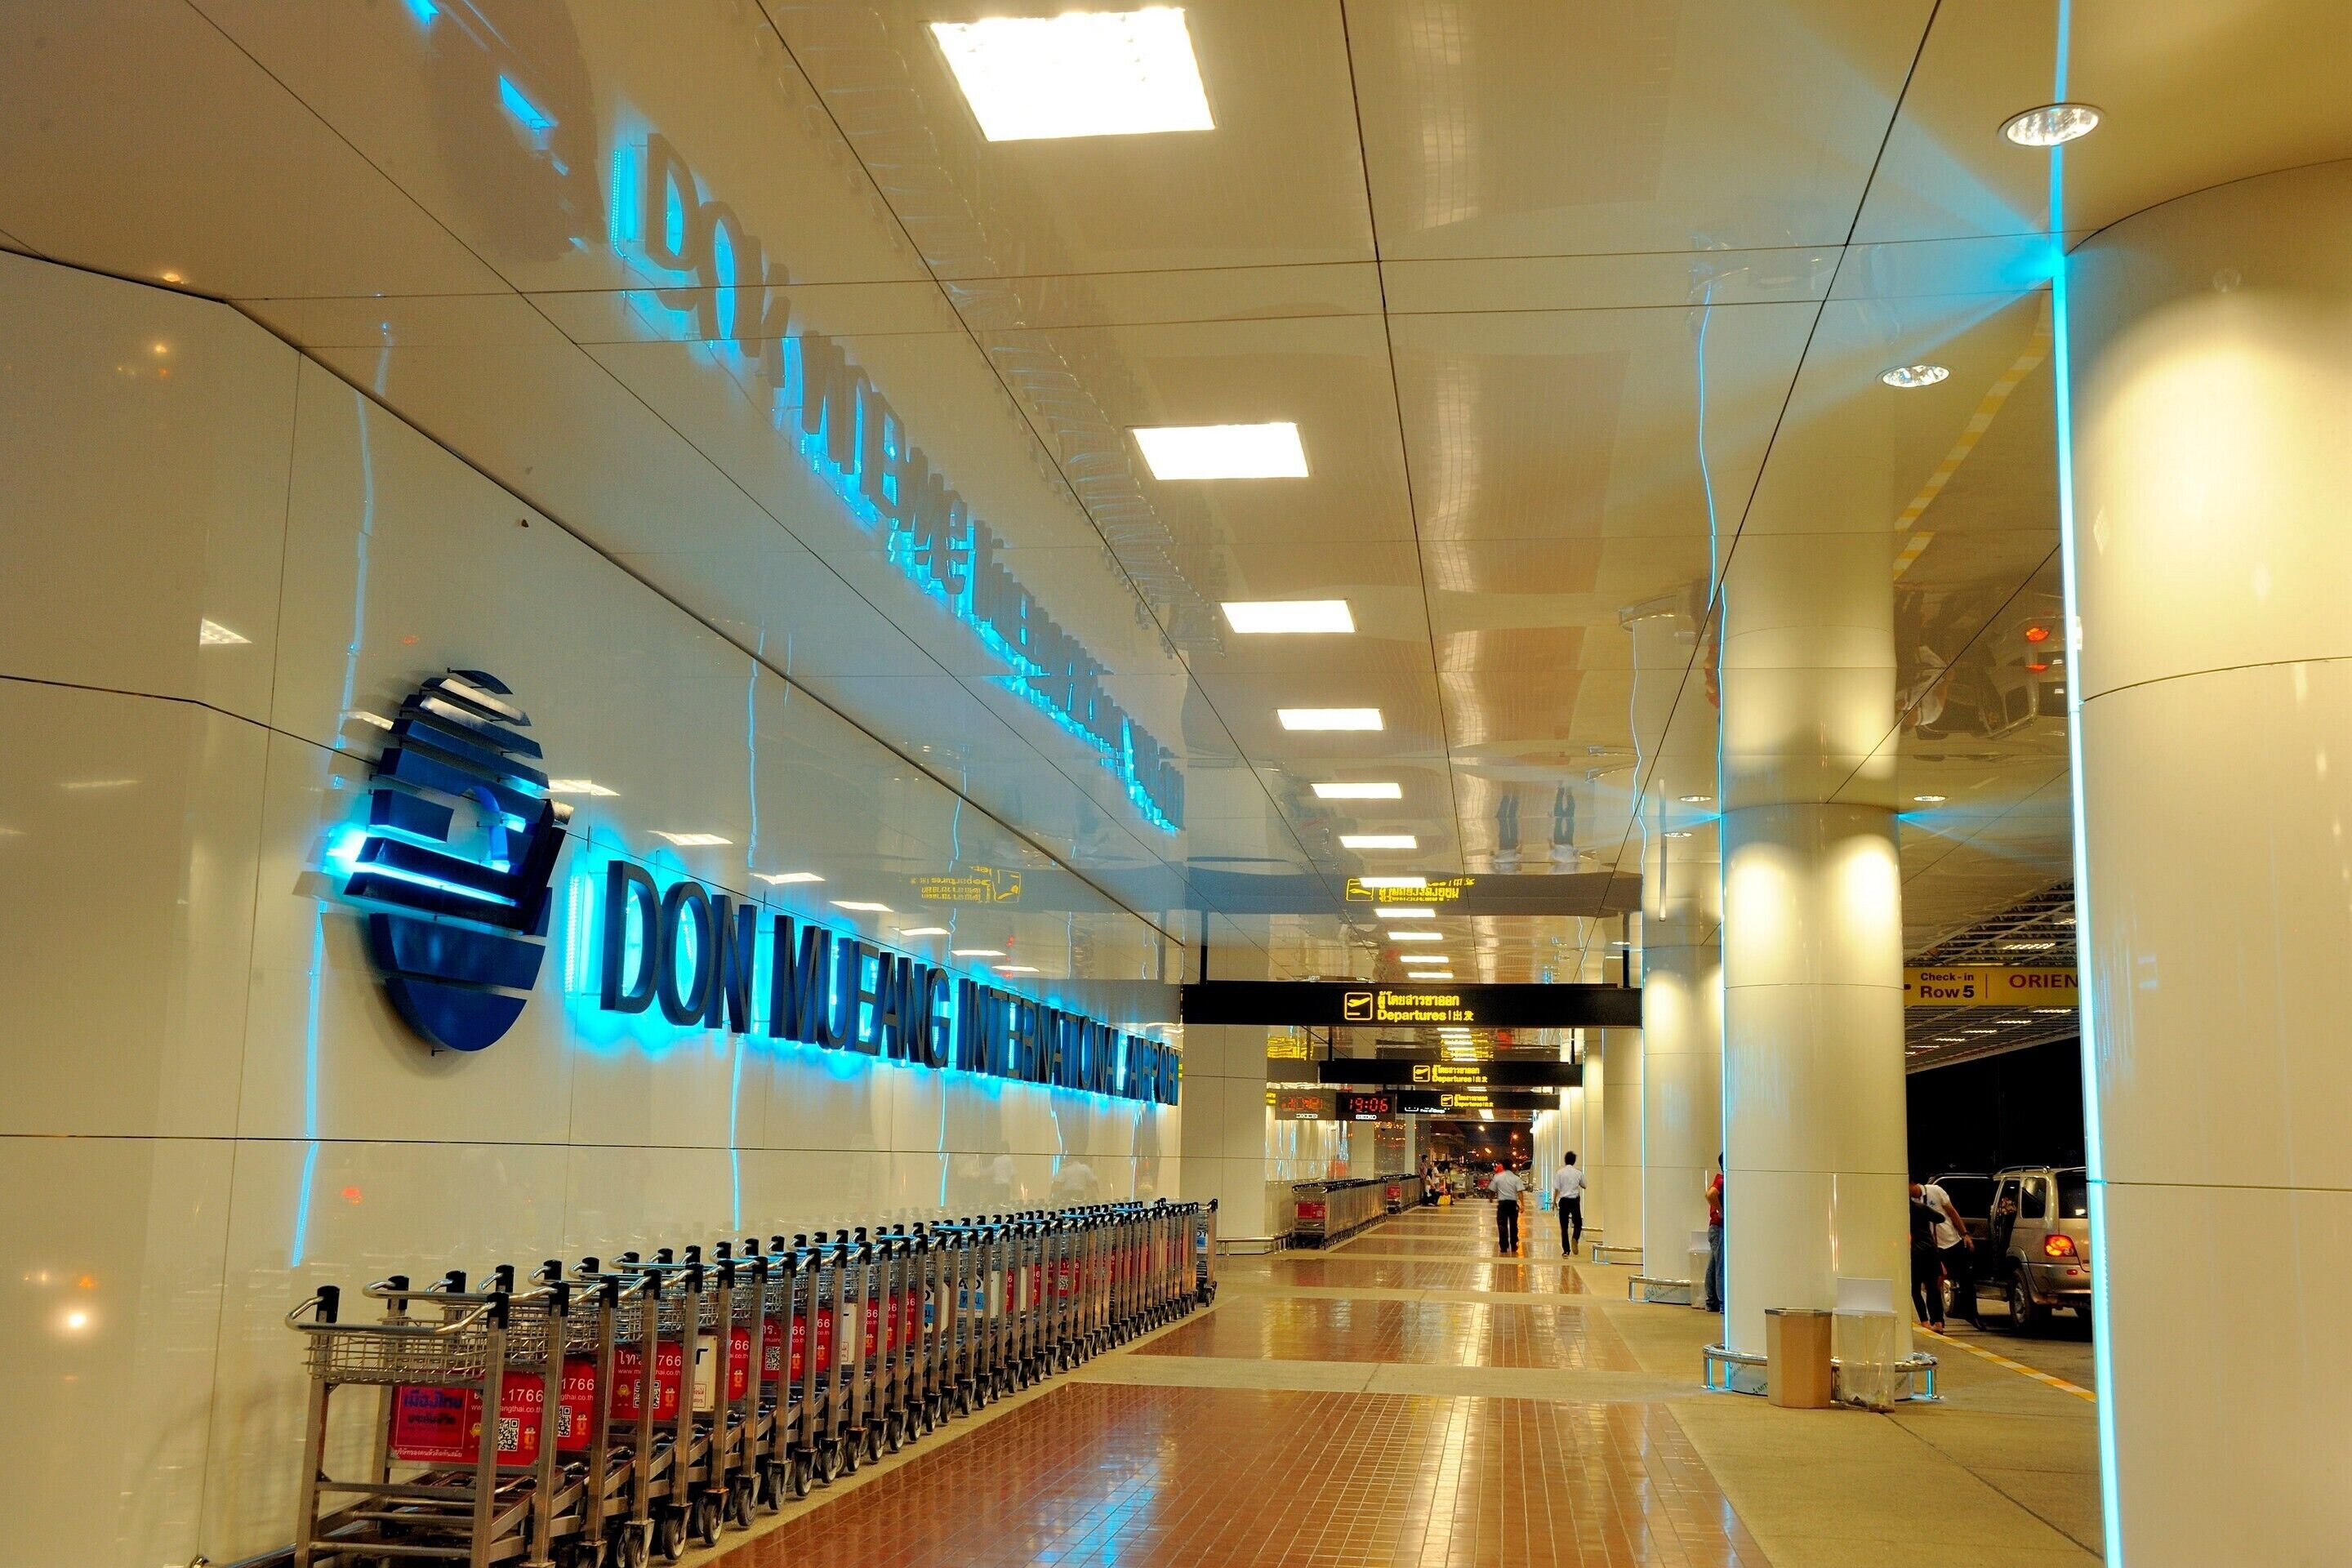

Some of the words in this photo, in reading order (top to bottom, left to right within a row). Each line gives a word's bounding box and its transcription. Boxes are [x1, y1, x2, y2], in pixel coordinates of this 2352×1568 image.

[600, 860, 757, 1034] DON
[769, 915, 951, 1067] MUEANG
[956, 978, 1125, 1097] INTERNATIONAL
[1920, 986, 1959, 998] Row
[1962, 985, 1975, 998] 5
[1378, 1009, 1446, 1022] Departures
[1349, 1098, 1388, 1112] 19:06
